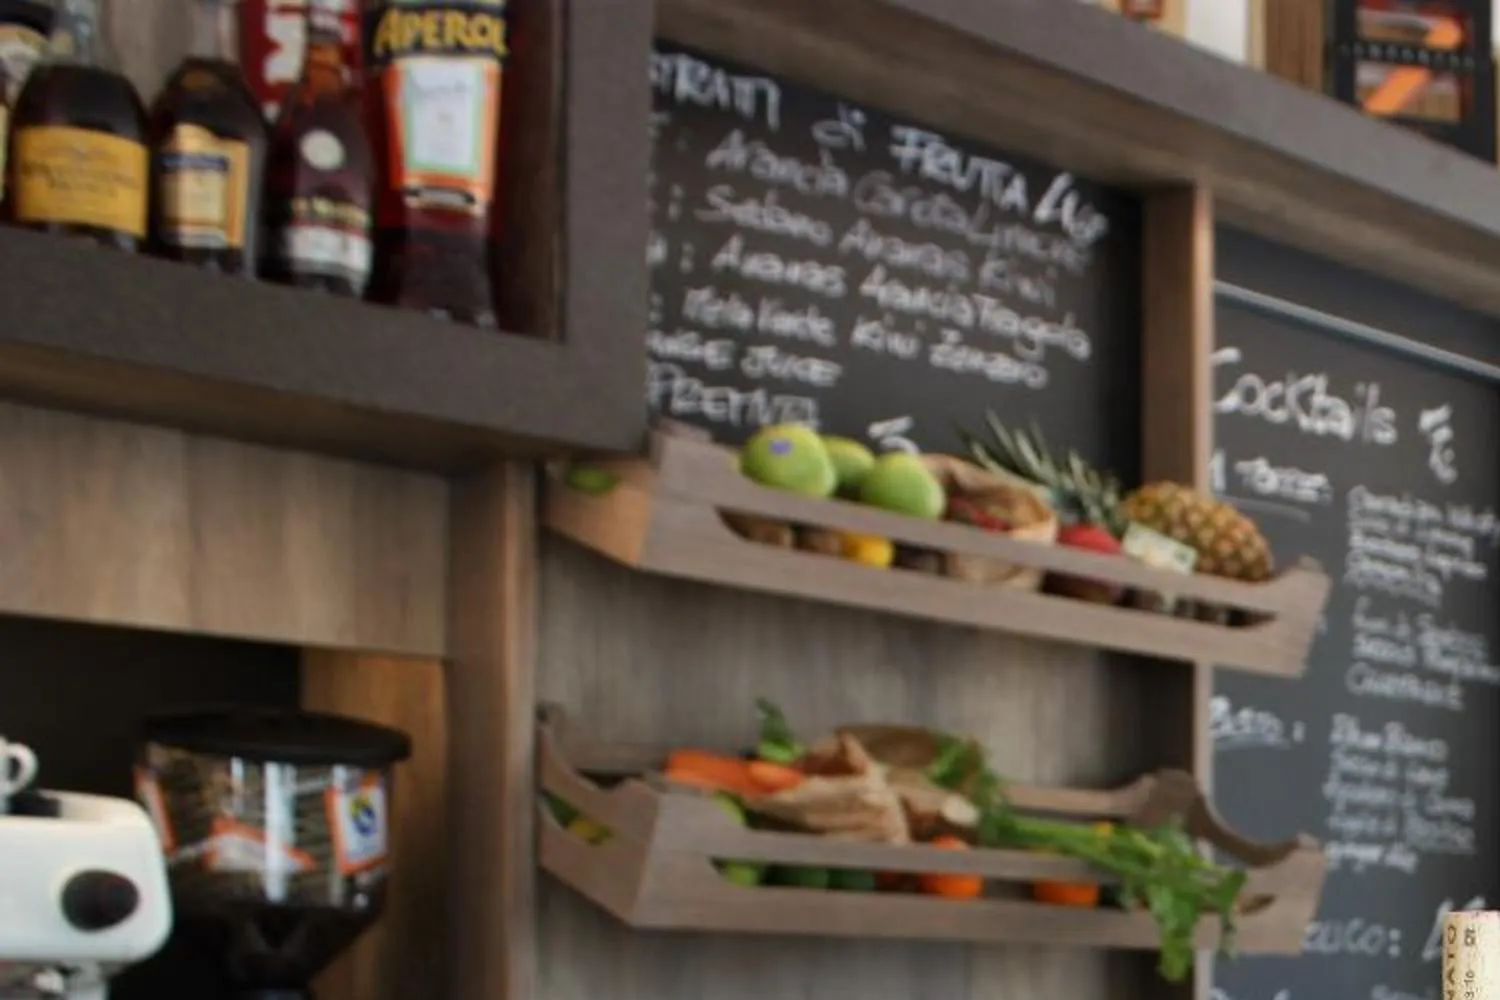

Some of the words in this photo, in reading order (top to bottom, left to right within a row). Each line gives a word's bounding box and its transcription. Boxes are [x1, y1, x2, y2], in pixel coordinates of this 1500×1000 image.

[374, 8, 509, 56] APEROL
[811, 101, 868, 151] di
[890, 124, 1028, 211] FRUTTA
